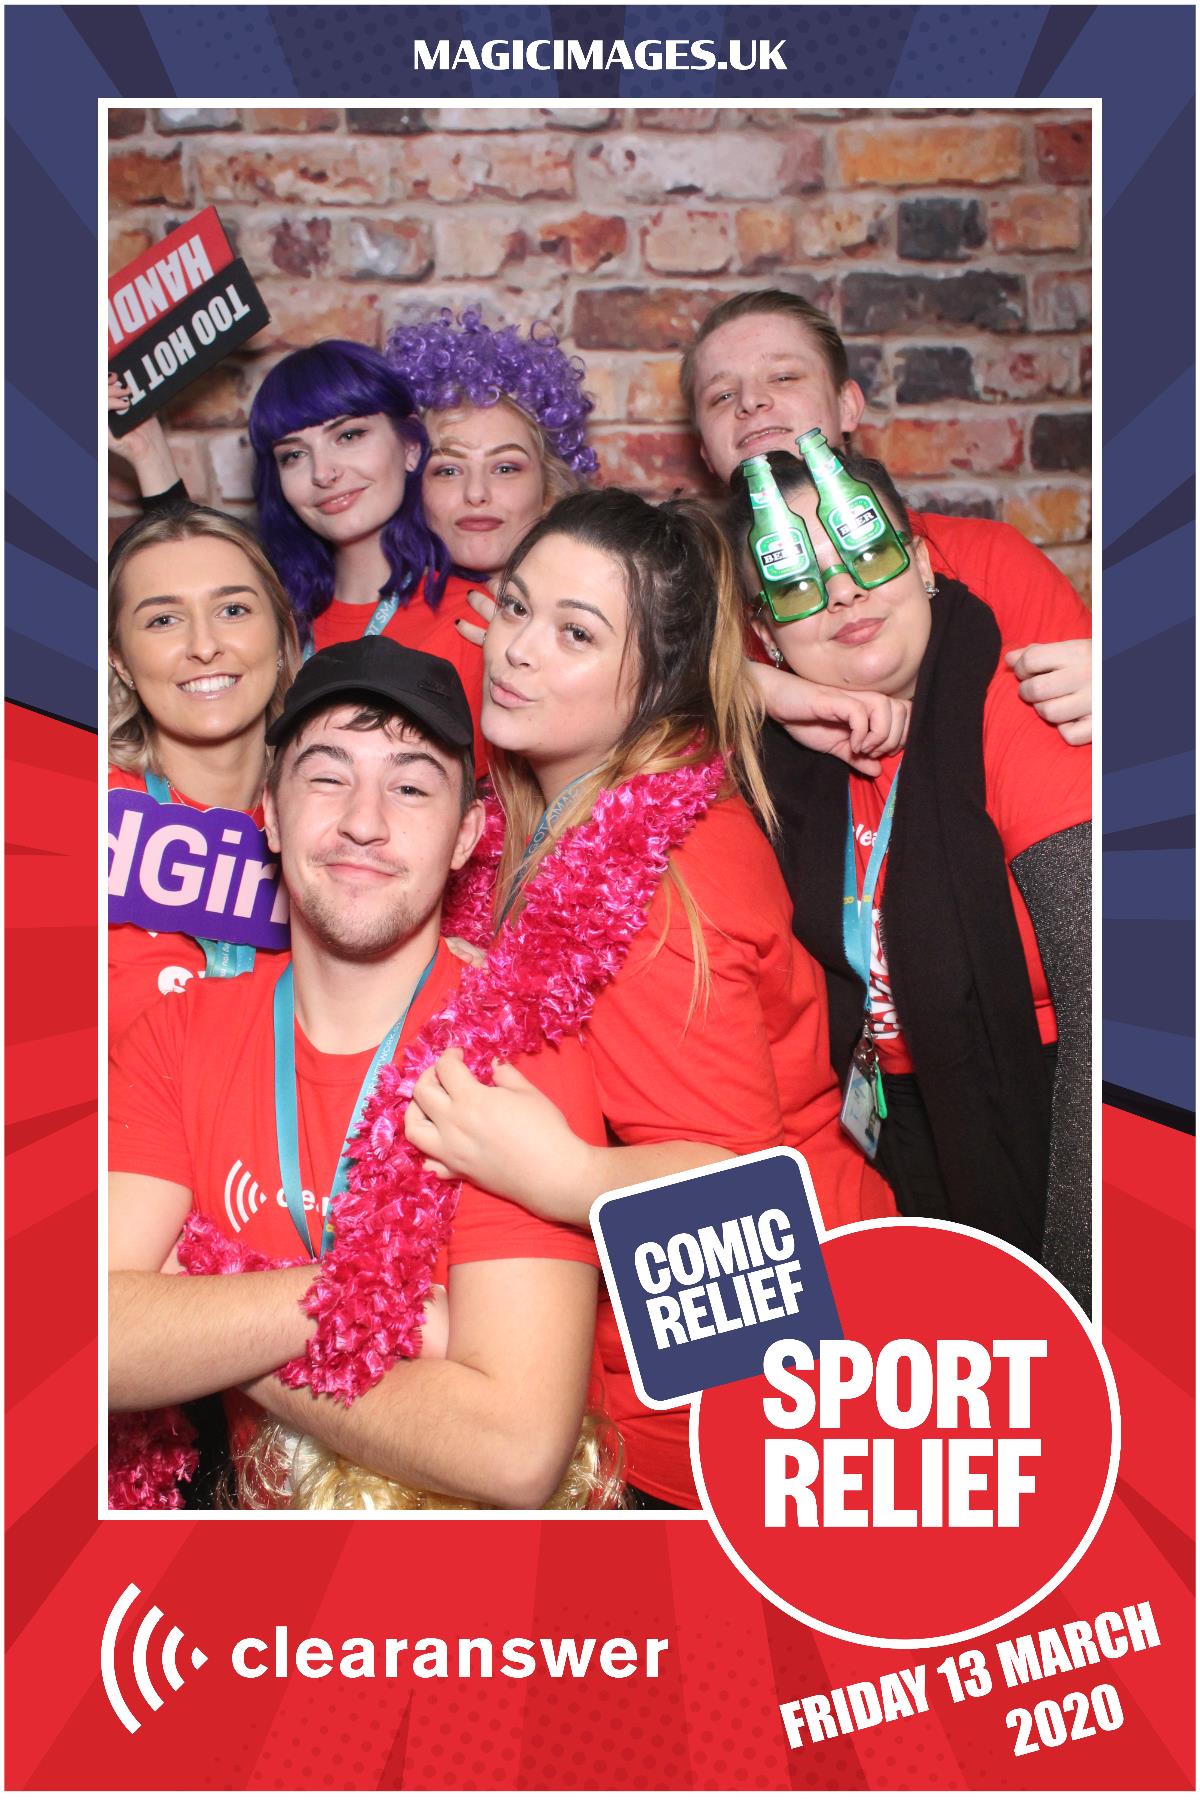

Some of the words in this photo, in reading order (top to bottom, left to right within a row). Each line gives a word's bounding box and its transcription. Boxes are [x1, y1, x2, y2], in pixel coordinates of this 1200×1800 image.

[191, 283, 251, 346] TOO
[141, 325, 197, 391] HOT
[115, 369, 147, 416] T
